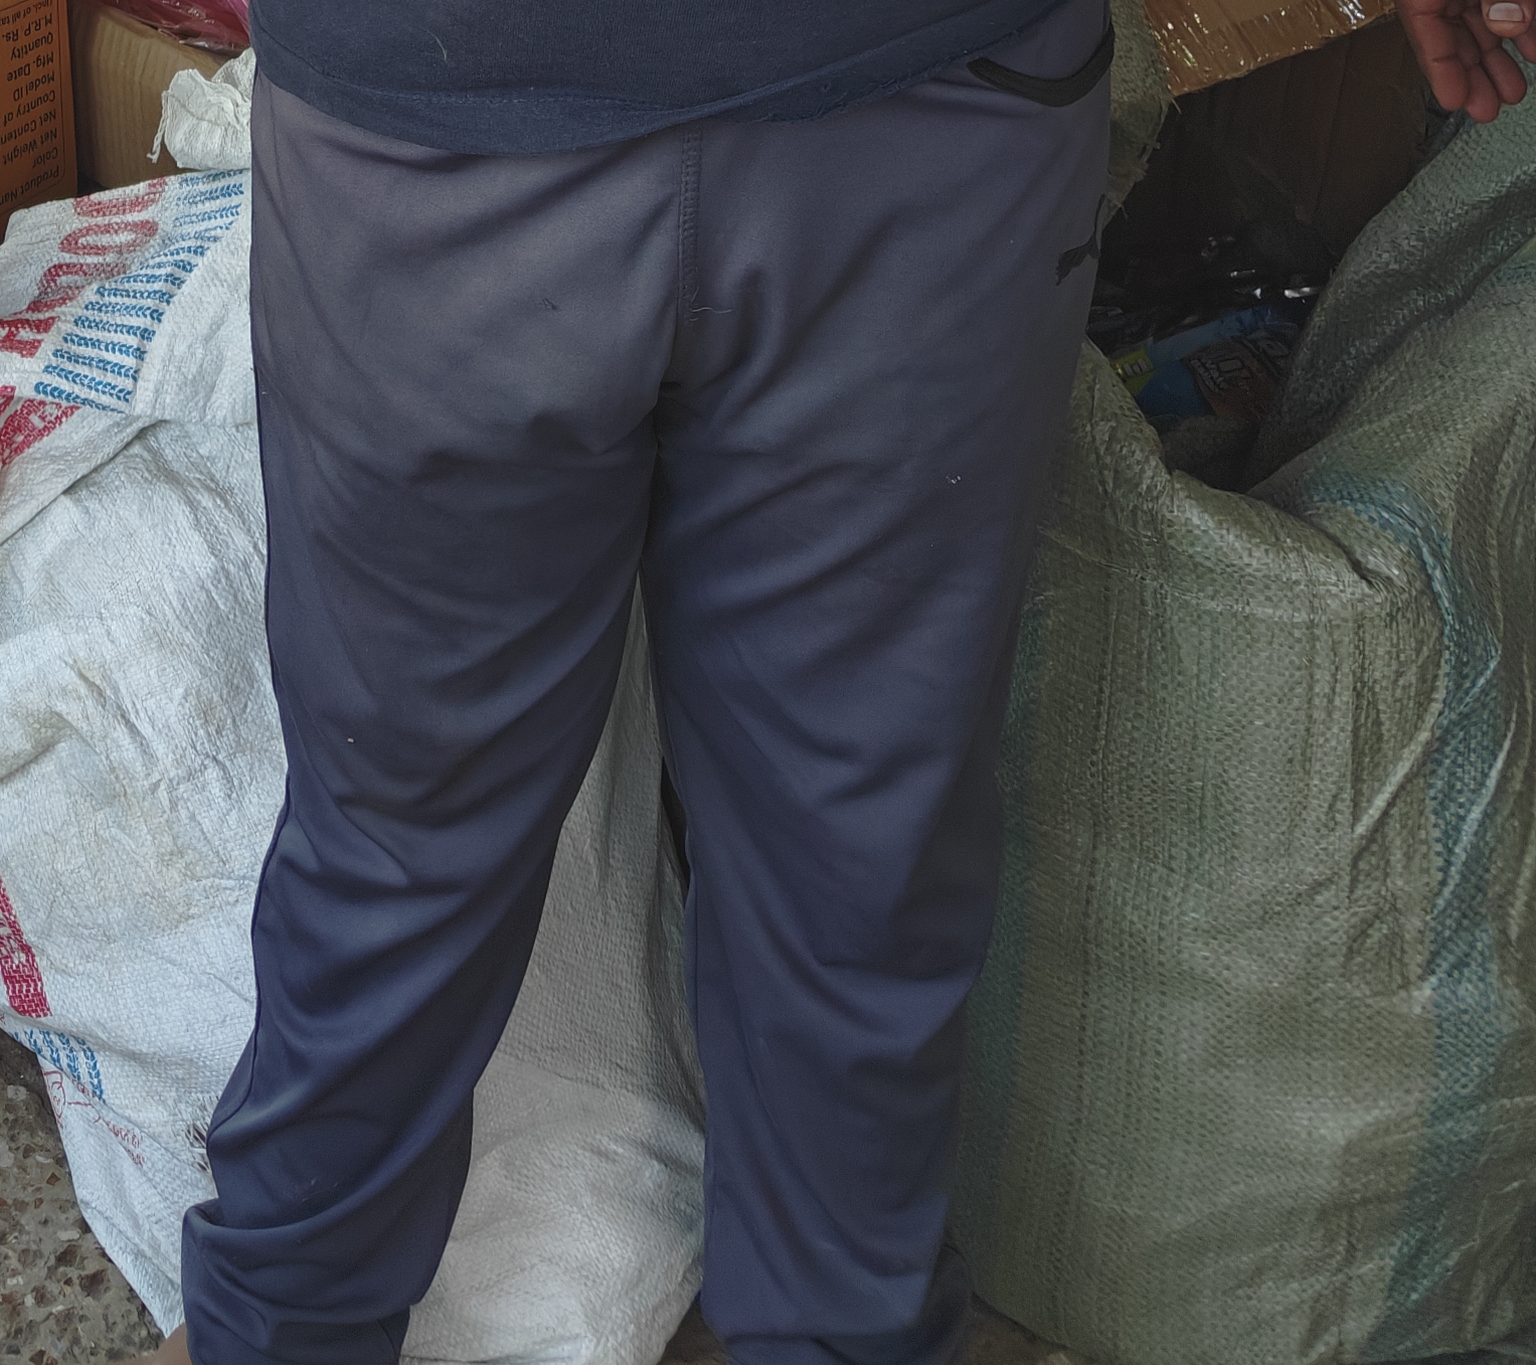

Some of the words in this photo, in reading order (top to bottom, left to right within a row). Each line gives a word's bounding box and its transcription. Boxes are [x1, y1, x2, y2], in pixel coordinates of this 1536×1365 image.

[10, 31, 54, 61] Quantity
[32, 51, 54, 69] Mfg.
[7, 66, 31, 82] Date
[26, 70, 55, 91] Model
[13, 86, 24, 102] ID
[16, 90, 56, 118] Country
[3, 112, 14, 127] of
[39, 108, 57, 123] Net
[40, 127, 58, 142] Net
[2, 139, 38, 165] Weight
[32, 146, 59, 169] Color
[20, 165, 59, 192] Product
